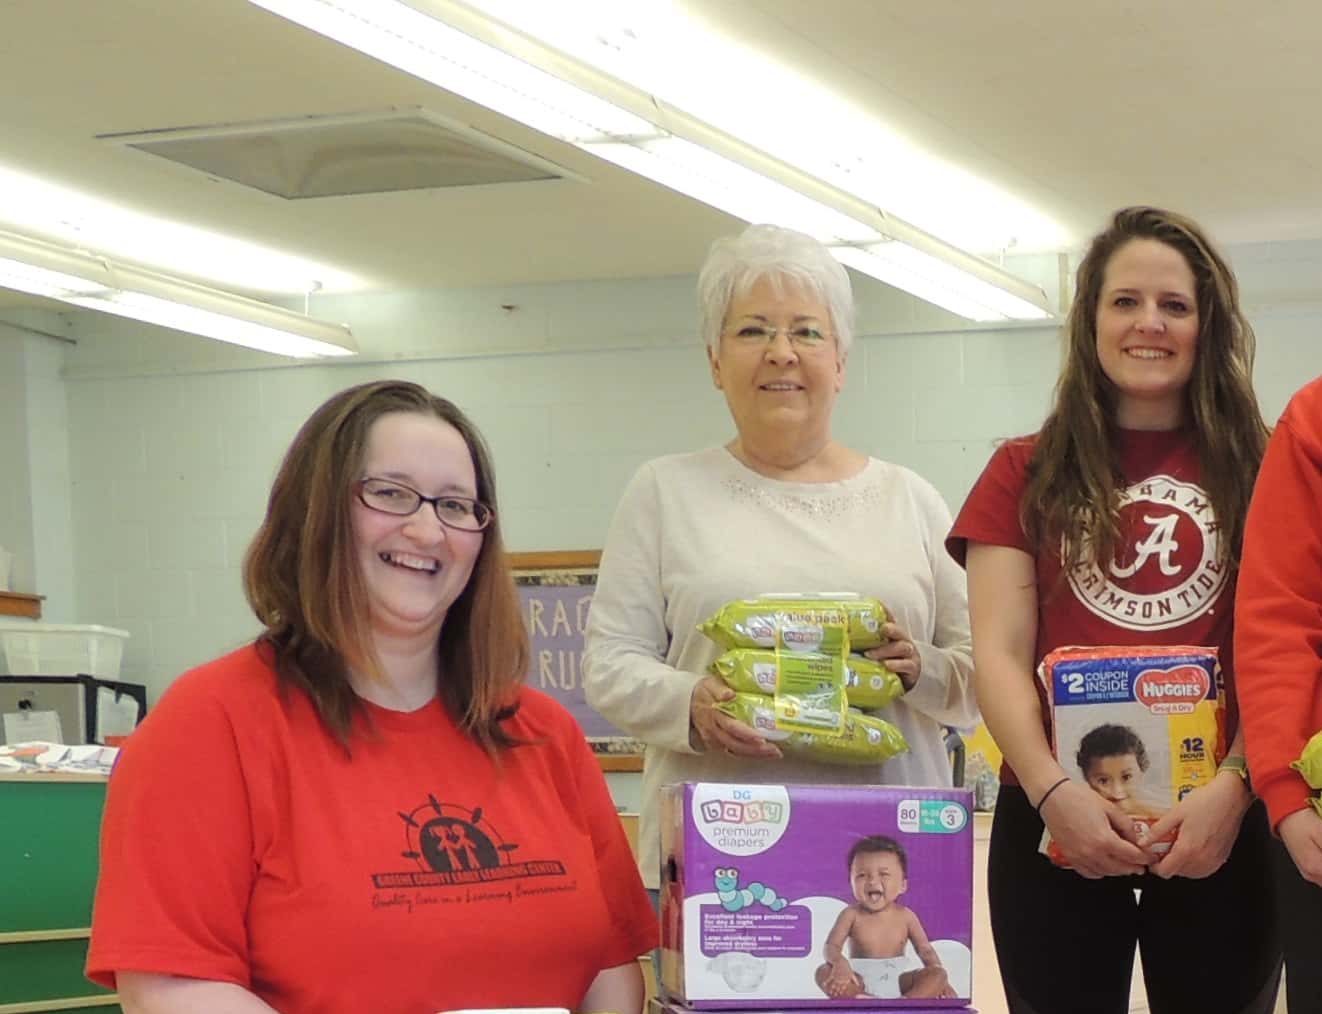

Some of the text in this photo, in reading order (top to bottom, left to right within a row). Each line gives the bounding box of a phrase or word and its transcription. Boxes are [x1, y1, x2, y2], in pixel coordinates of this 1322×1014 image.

[1109, 514, 1182, 578] A
[1075, 559, 1225, 619] CRIMSON TIDE
[539, 650, 592, 690] RU
[1061, 671, 1129, 693] $2 COUPON
[1086, 680, 1129, 693] INSIDE
[1143, 681, 1201, 697] HUGGIES
[1182, 737, 1204, 752] 12
[733, 790, 752, 800] DG
[703, 801, 782, 823] baby
[901, 808, 916, 820] 80
[946, 814, 956, 826] 3
[713, 826, 769, 838] premium
[718, 837, 766, 848] diapers
